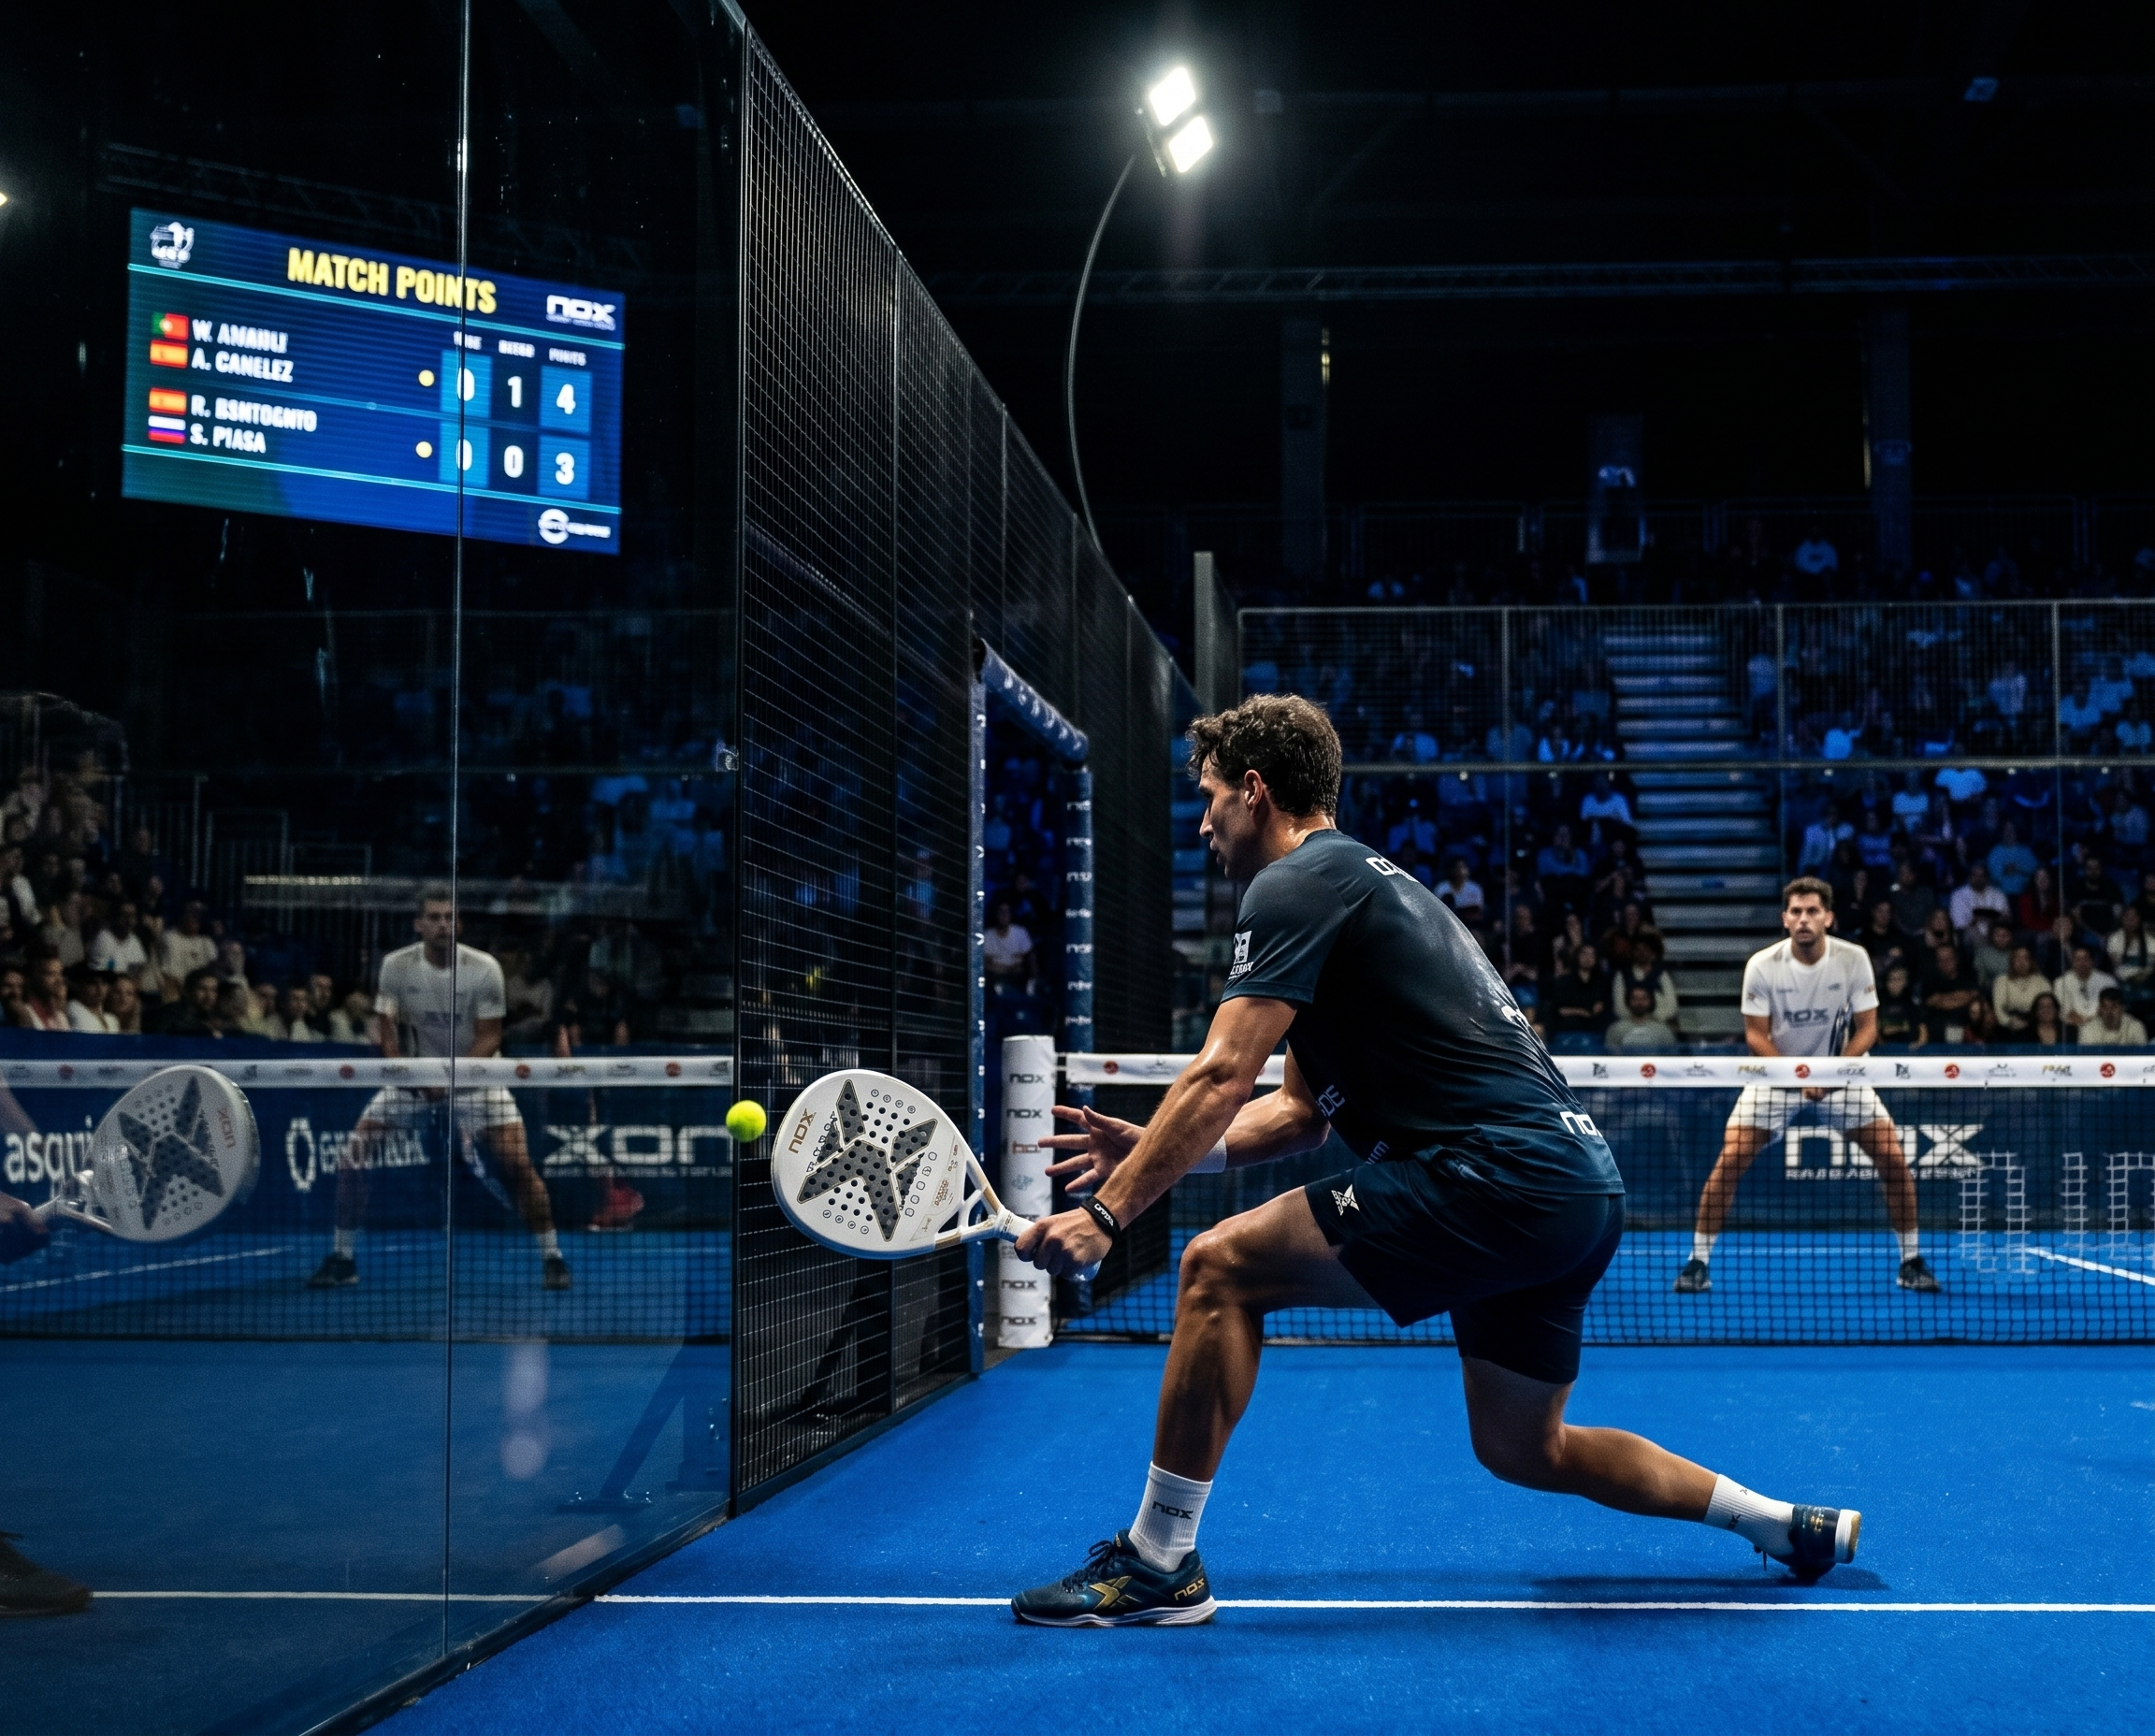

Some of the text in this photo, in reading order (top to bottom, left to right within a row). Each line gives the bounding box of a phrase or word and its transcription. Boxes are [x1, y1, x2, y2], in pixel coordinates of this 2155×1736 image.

[287, 247, 498, 314] MATCH POINTS
[192, 319, 213, 342] W.
[191, 347, 211, 370] A.
[191, 394, 211, 417] R.
[507, 376, 522, 408] 1
[557, 383, 576, 414] 4
[190, 423, 209, 446] S.
[504, 444, 524, 478] 0
[555, 452, 575, 485] 3
